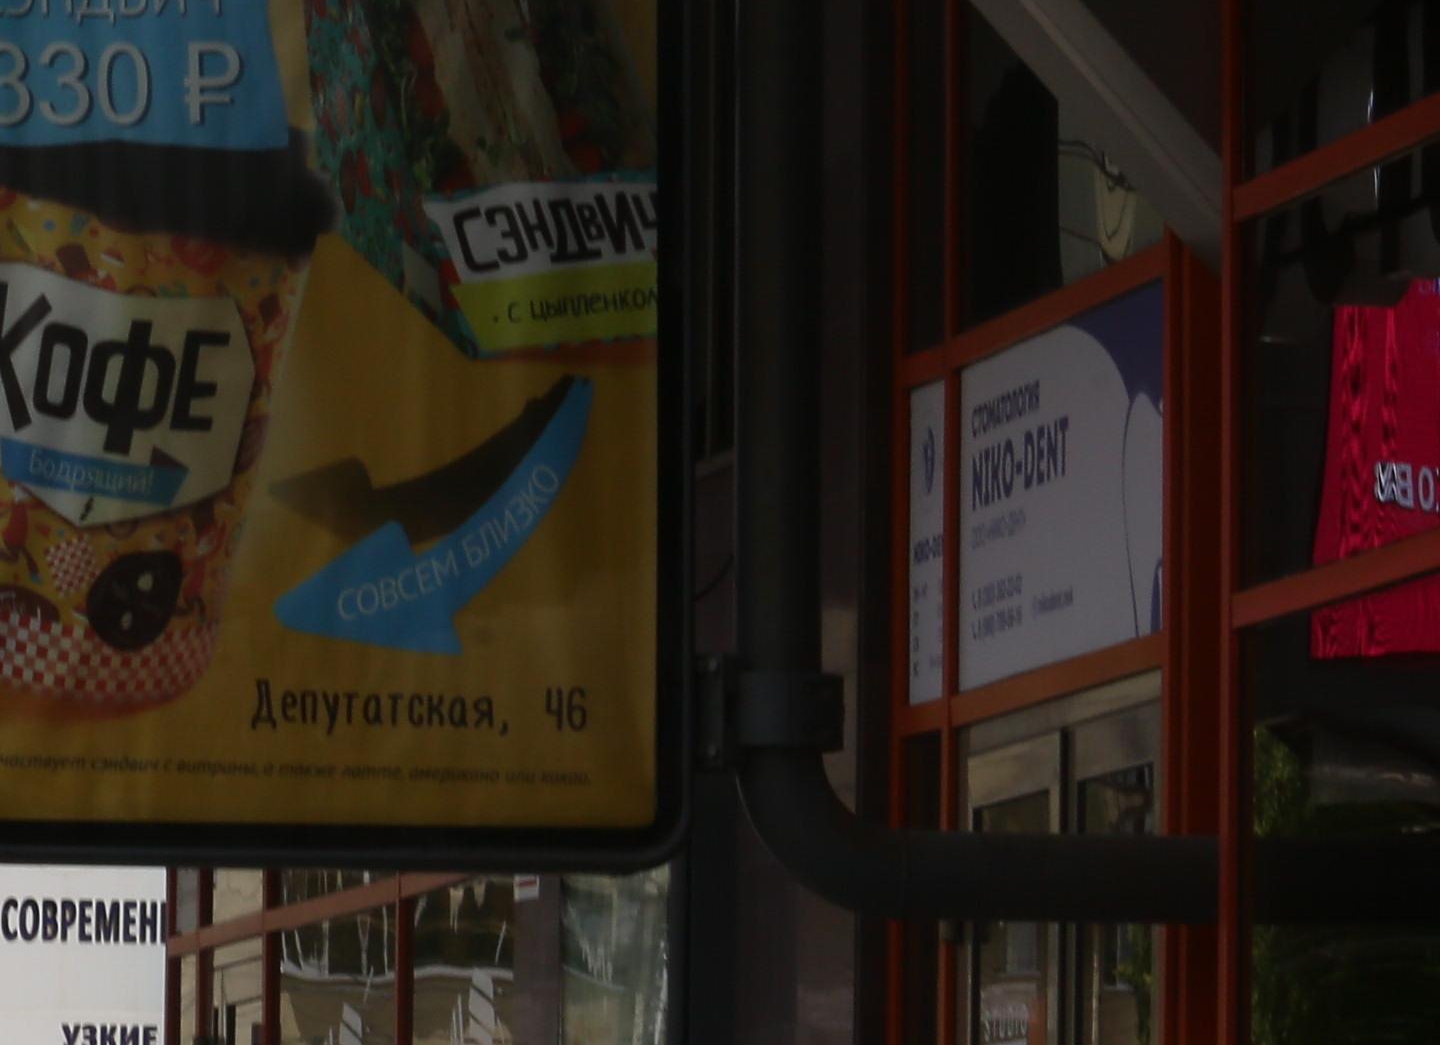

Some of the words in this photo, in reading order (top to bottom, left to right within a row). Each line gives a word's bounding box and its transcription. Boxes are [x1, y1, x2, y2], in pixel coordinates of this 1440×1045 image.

[971, 380, 1040, 438] СТОМАТОЛОГИЯ
[29, 450, 156, 494] Бодрящий!
[971, 416, 1069, 513] NIKO-DENT
[336, 549, 460, 622] СОВСЕМ
[463, 462, 560, 568] БЛИЗКО
[250, 679, 509, 737] Депутатская,
